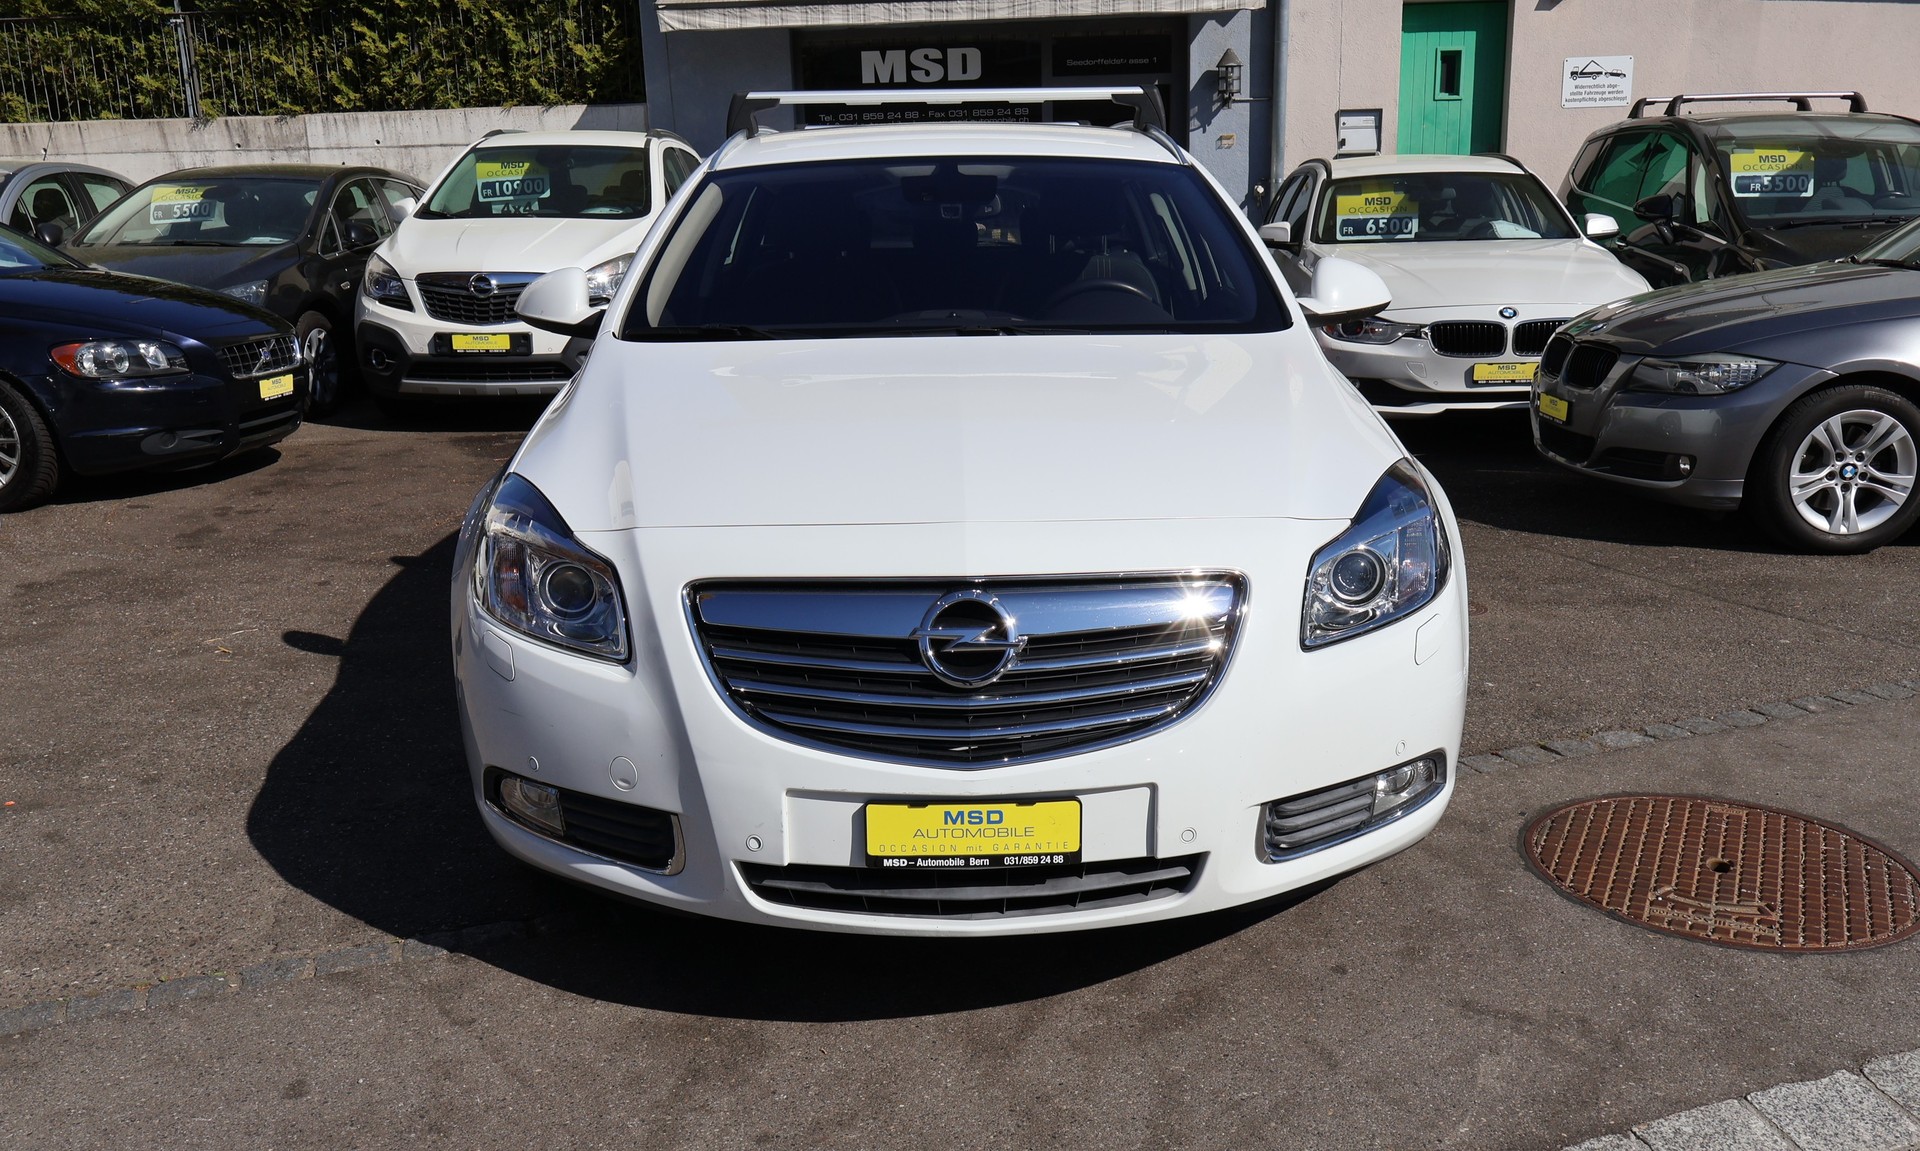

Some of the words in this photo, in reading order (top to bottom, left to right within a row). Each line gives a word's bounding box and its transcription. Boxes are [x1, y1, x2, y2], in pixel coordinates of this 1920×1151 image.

[860, 47, 982, 84] MSD
[838, 113, 858, 121] 031
[863, 112, 884, 120] 859
[904, 111, 919, 119] 88
[928, 110, 946, 118] Fax
[948, 109, 968, 118] 031
[972, 108, 994, 117] 859
[997, 108, 1011, 116] 24
[1014, 107, 1029, 115] 89
[501, 161, 525, 169] MSD
[1759, 155, 1786, 163] MSD
[1742, 163, 1803, 171] OCCASION
[482, 189, 493, 197] FR
[495, 179, 544, 196] 10900
[1750, 183, 1761, 191] FR
[1762, 176, 1808, 192] 5500
[1364, 197, 1391, 206] MSD
[154, 211, 163, 219] FR
[173, 202, 209, 218] 5500
[1348, 206, 1407, 214] OCCASION
[1343, 226, 1354, 235] FR
[1366, 218, 1412, 234] 6500
[943, 809, 1004, 825] MSD
[912, 826, 1035, 839] AUTOMOBILE
[879, 843, 958, 853] OCCASION
[966, 843, 983, 852] mit
[992, 841, 1069, 852] GARANTIE
[883, 858, 908, 867] MSD
[916, 857, 965, 867] Automobile
[969, 857, 990, 866] Bern
[1004, 855, 1039, 866] 031/859
[1040, 855, 1051, 864] 24
[1053, 854, 1064, 864] 88
